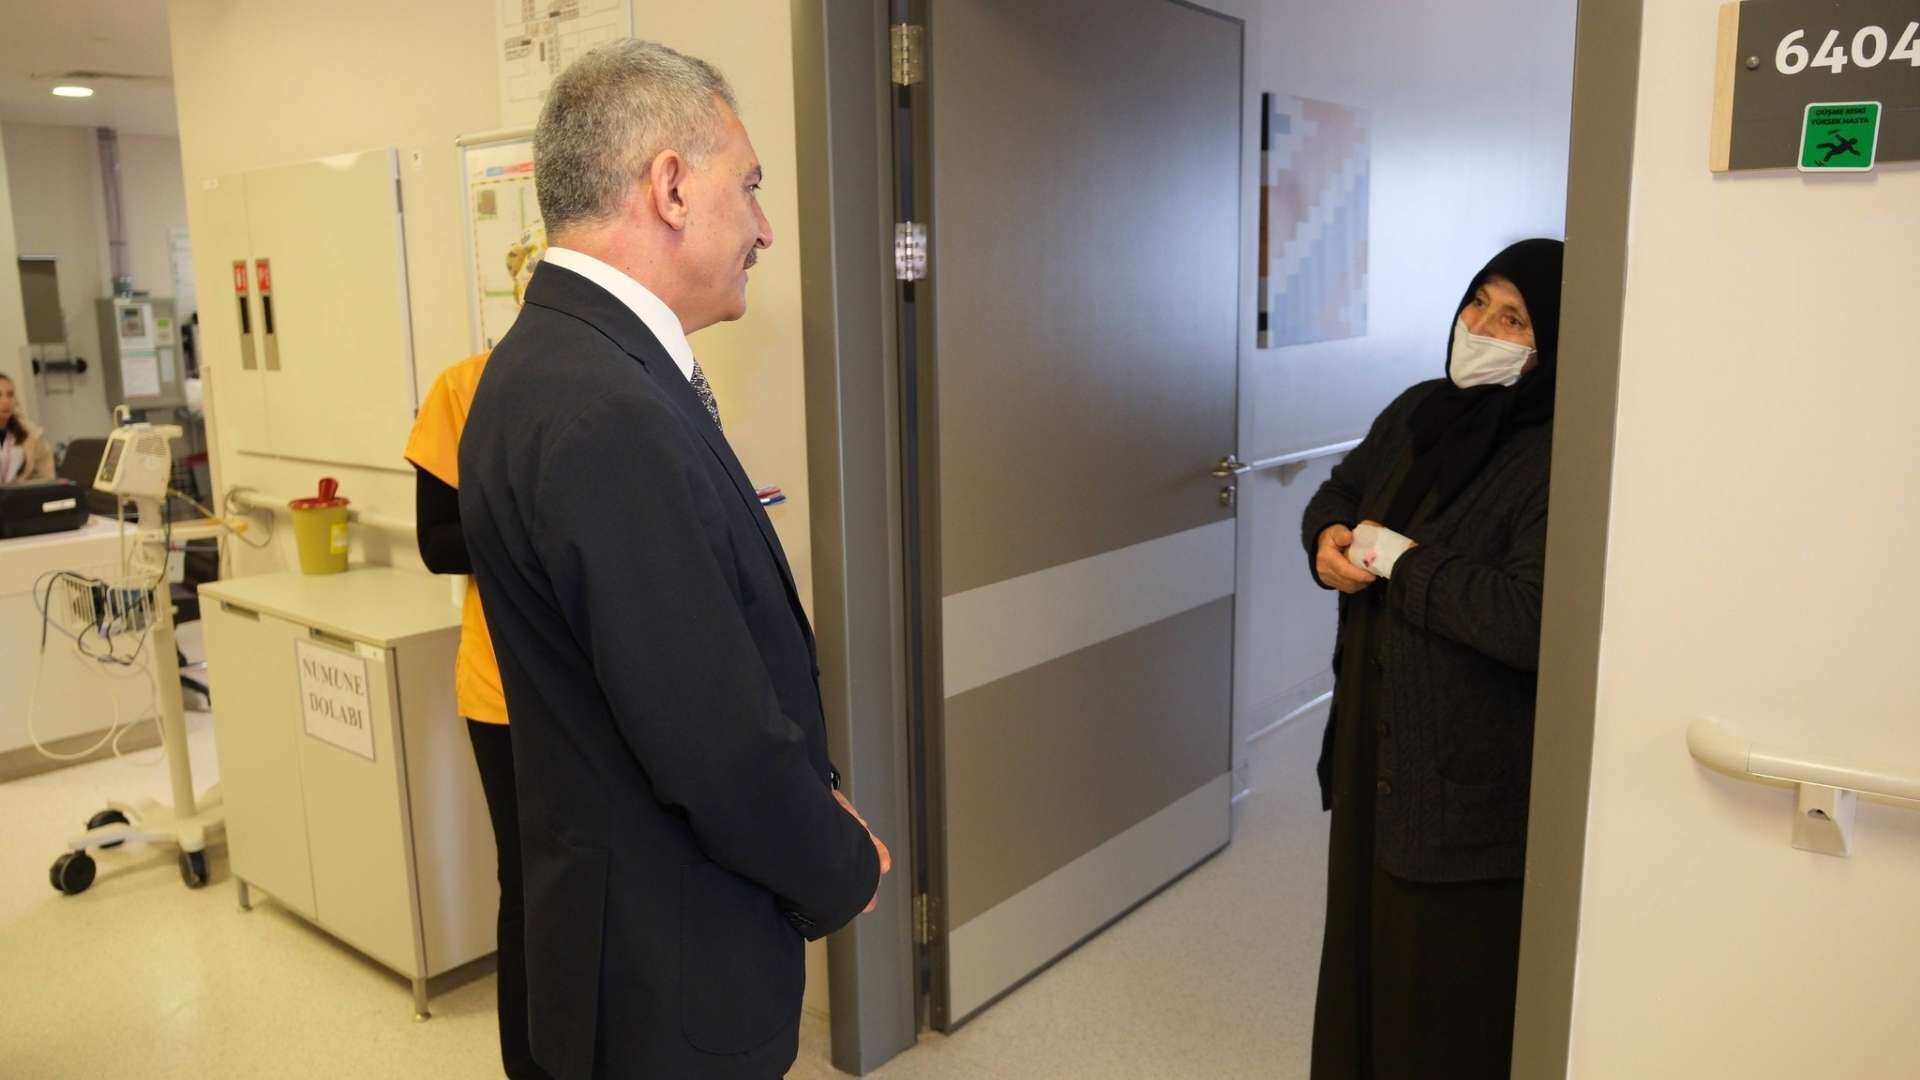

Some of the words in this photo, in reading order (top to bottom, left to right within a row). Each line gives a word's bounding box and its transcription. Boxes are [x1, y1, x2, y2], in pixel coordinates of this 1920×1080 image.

[1775, 21, 1920, 75] 6404
[1843, 117, 1869, 125] HASTA
[302, 658, 365, 697] NUMUNE
[309, 692, 363, 729] DOLABI
